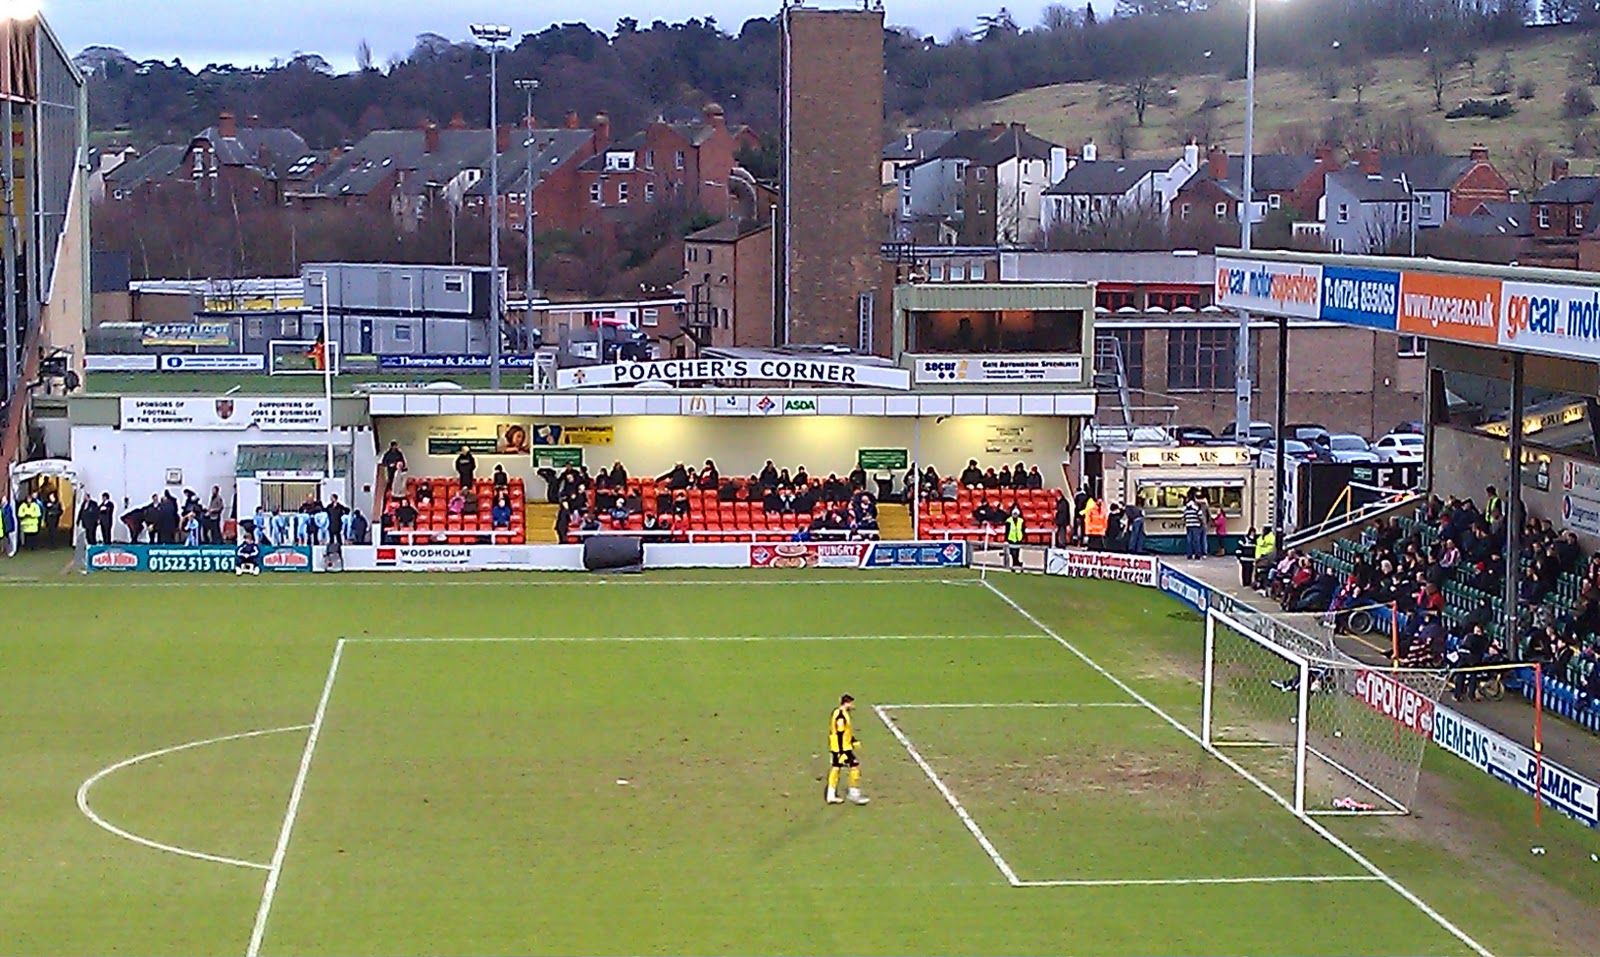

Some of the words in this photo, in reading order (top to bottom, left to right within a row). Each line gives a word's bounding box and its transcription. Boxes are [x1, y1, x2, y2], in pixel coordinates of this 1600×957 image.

[1404, 292, 1495, 328] www.gocar.co.uk
[400, 356, 445, 367] Thompson
[457, 356, 505, 366] Richardn
[614, 360, 748, 381] POACHER'S
[760, 361, 856, 382] CORNER
[785, 400, 816, 411] ASDA
[400, 549, 472, 557] WOODHOLME
[818, 544, 863, 556] HUNGRY?
[149, 557, 187, 571] 01522
[188, 557, 211, 570] 513
[214, 557, 236, 571] 161
[1435, 711, 1490, 767] SIEMENS
[1526, 758, 1582, 809] RLMAC
